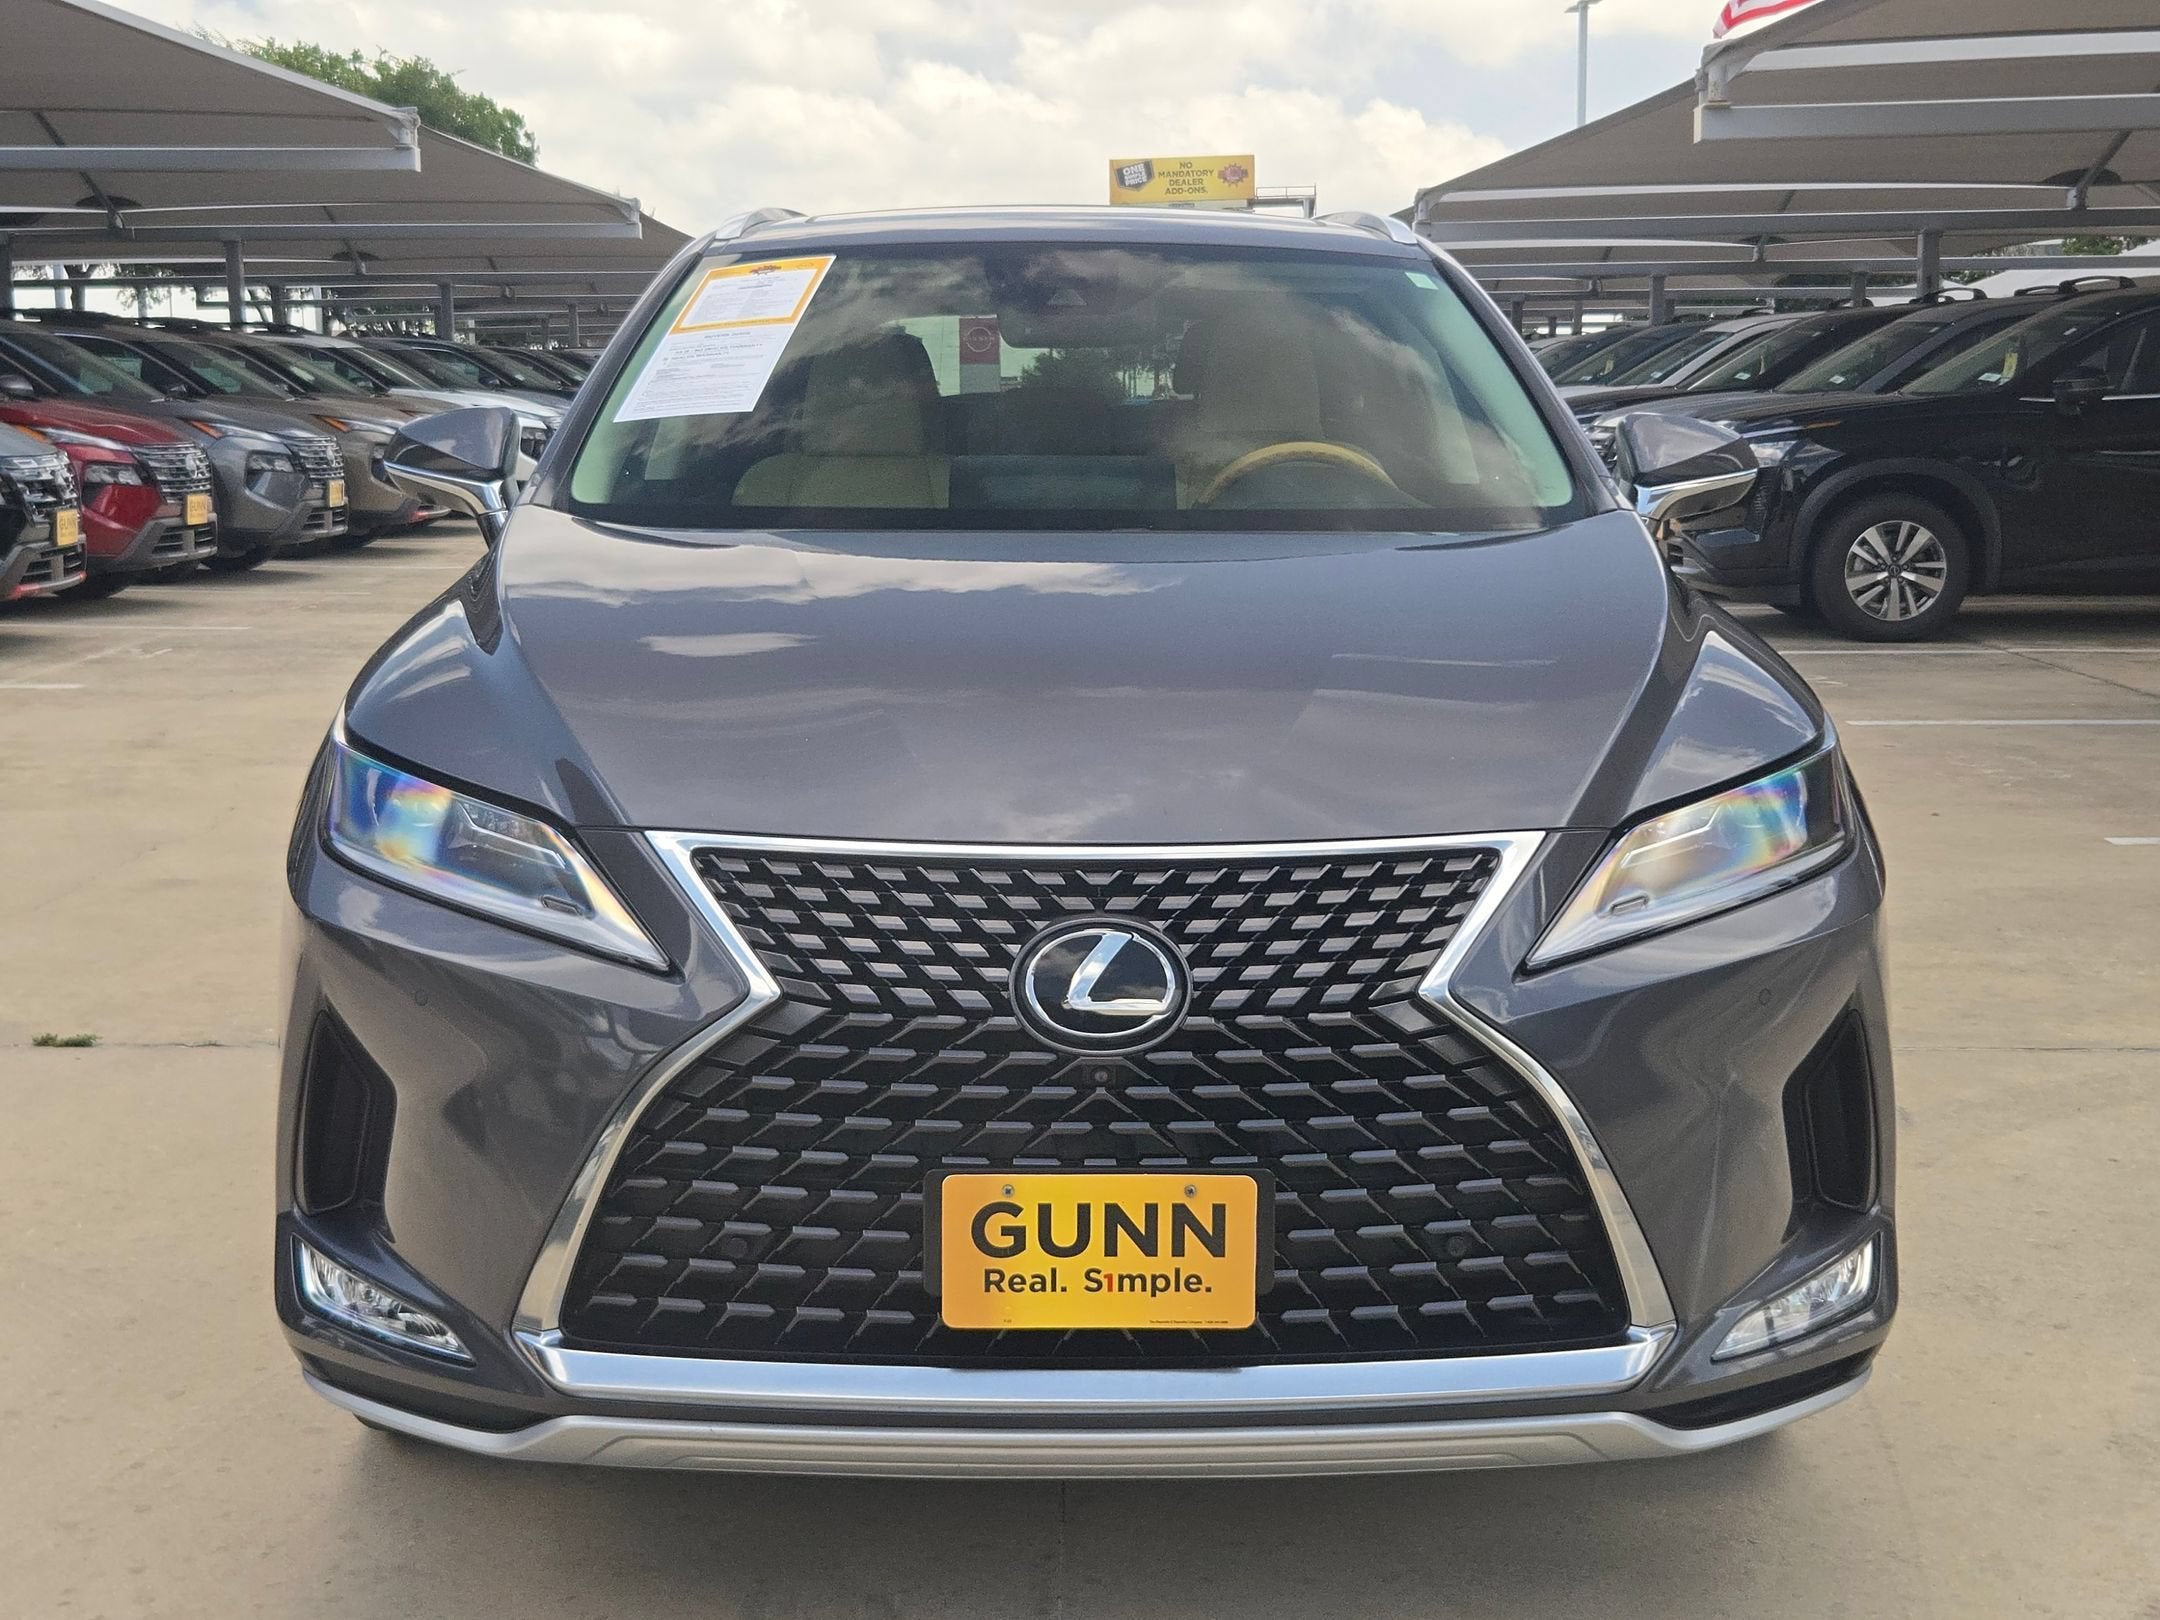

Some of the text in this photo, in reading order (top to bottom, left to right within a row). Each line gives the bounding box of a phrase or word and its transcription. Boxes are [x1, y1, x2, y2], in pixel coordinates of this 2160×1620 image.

[1123, 163, 1145, 175] ONE
[1179, 161, 1192, 169] NO
[1158, 169, 1214, 178] MANDATORY
[1169, 178, 1204, 187] DEALER
[971, 1201, 1226, 1258] GUNN
[984, 1267, 1067, 1293] Real.
